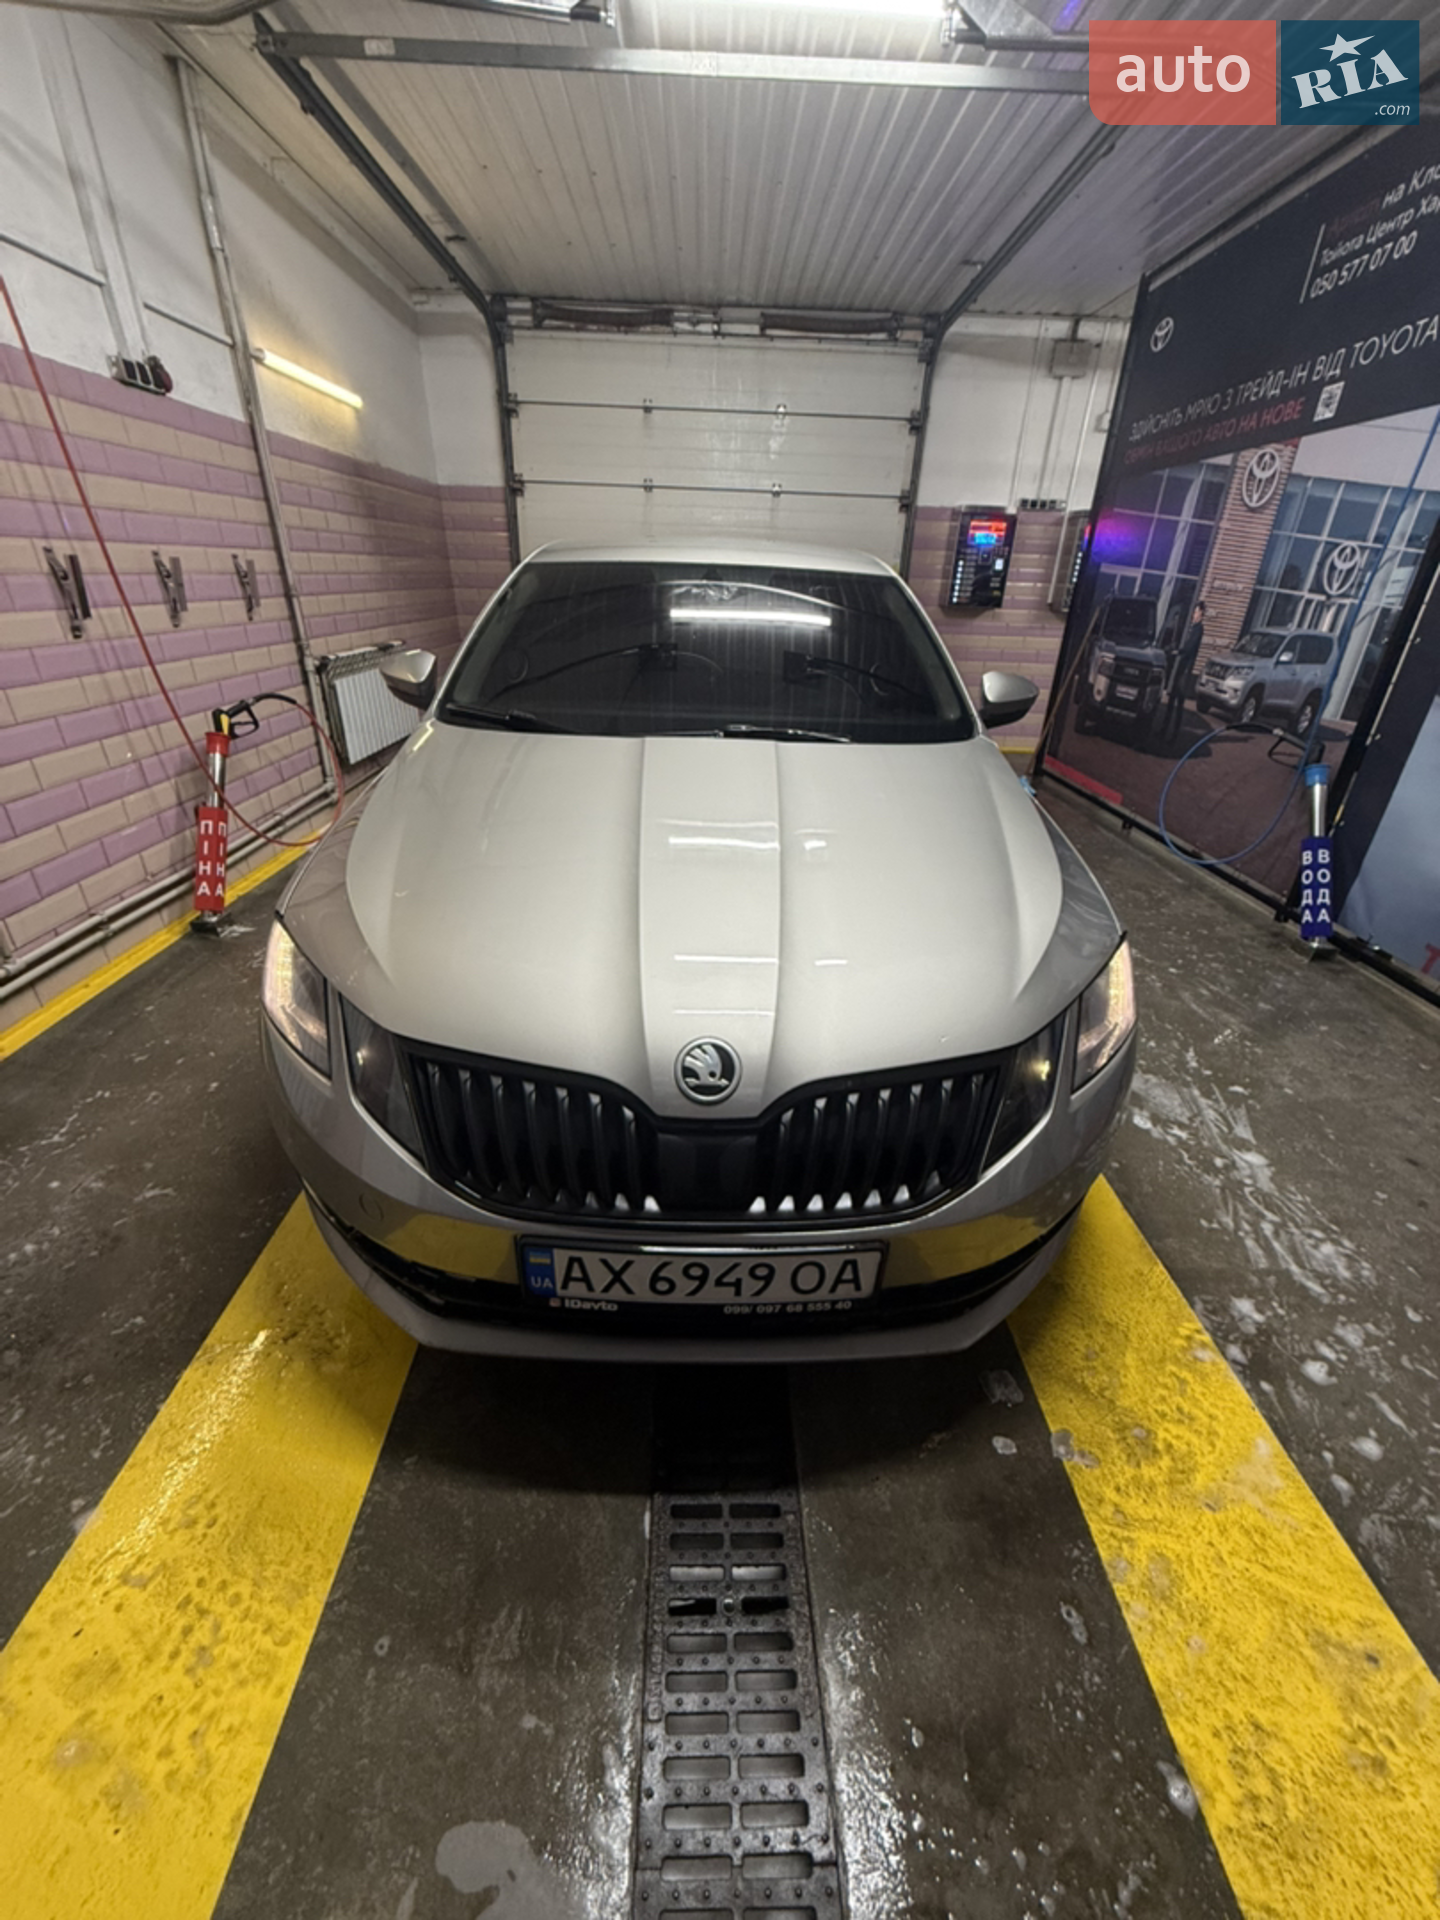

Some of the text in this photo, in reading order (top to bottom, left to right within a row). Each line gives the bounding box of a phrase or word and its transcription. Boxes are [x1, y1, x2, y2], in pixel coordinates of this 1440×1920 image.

[1365, 208, 1415, 245] Центр
[1382, 183, 1405, 209] на
[1310, 230, 1418, 298] 050 577 07 00
[1312, 348, 1346, 381] ВІД
[1350, 314, 1440, 369] TOYOTA
[1204, 418, 1236, 443] АВТО
[1238, 413, 1257, 435] НА
[1260, 397, 1306, 429] НОВЕ
[197, 820, 213, 896] ПІНА
[215, 822, 227, 897] ПІНА
[1301, 850, 1314, 924] ВОДА
[1317, 848, 1331, 924] ВОДА
[530, 1276, 553, 1289] UA
[560, 1256, 862, 1297] AX 6949 OA
